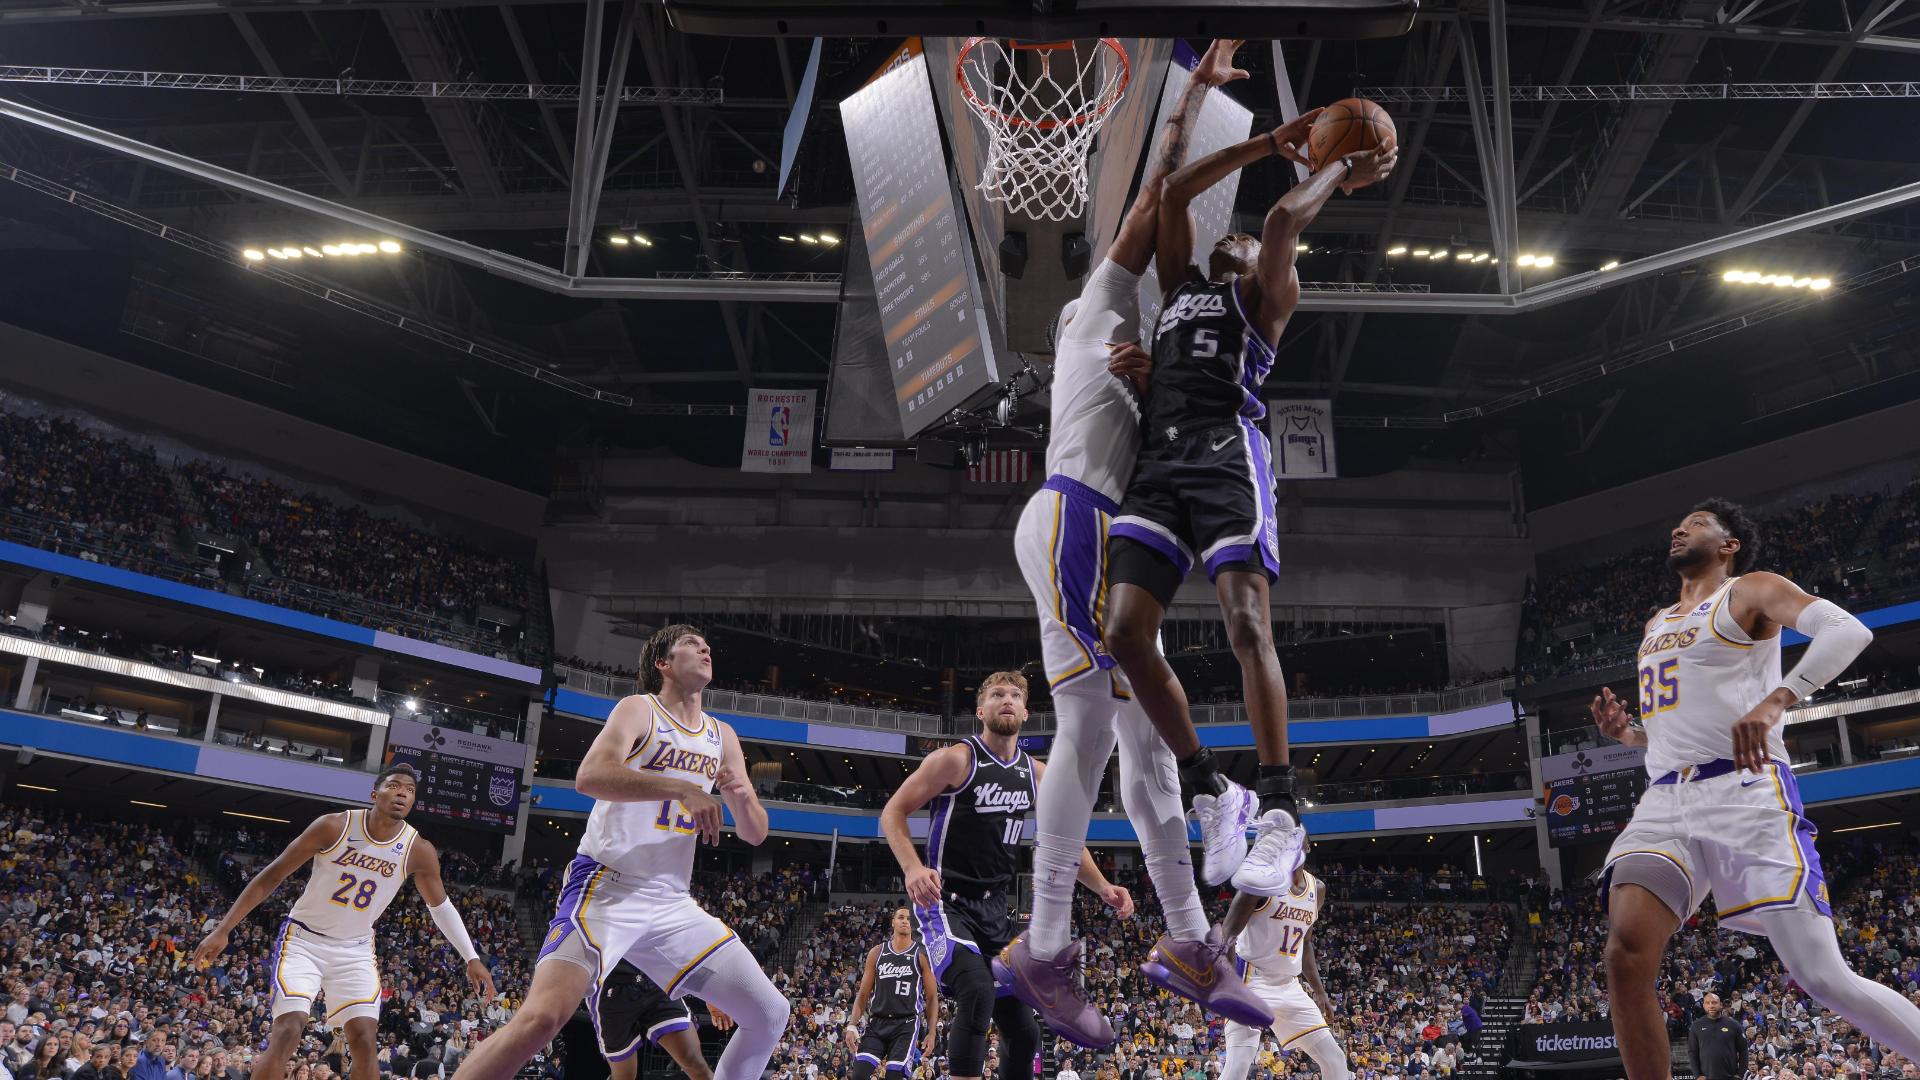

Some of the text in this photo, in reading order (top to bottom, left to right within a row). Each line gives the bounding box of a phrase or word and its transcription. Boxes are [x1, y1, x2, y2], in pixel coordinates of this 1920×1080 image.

[914, 299, 936, 321] FOULS
[1192, 328, 1219, 357] 5
[920, 353, 953, 382] TIMEOUTS
[757, 395, 808, 403] ROCHESTER
[1304, 405, 1324, 416] MAN
[1308, 447, 1316, 457] 6
[1640, 658, 1680, 719] 35
[394, 744, 422, 757] LAKERS
[494, 765, 515, 774] KINGS
[641, 741, 718, 779] LAKERS
[490, 787, 513, 798] KINGS
[1550, 779, 1575, 788] LAKERS
[974, 783, 1030, 813] Kings
[1003, 818, 1023, 845] 10
[331, 845, 397, 878] LAKERS
[328, 872, 377, 912] 28
[1270, 902, 1313, 925] LAKERS
[1280, 925, 1303, 957] 12
[878, 962, 913, 979] Kings
[894, 981, 911, 997] 13
[1536, 1035, 1619, 1051] ticketmast
